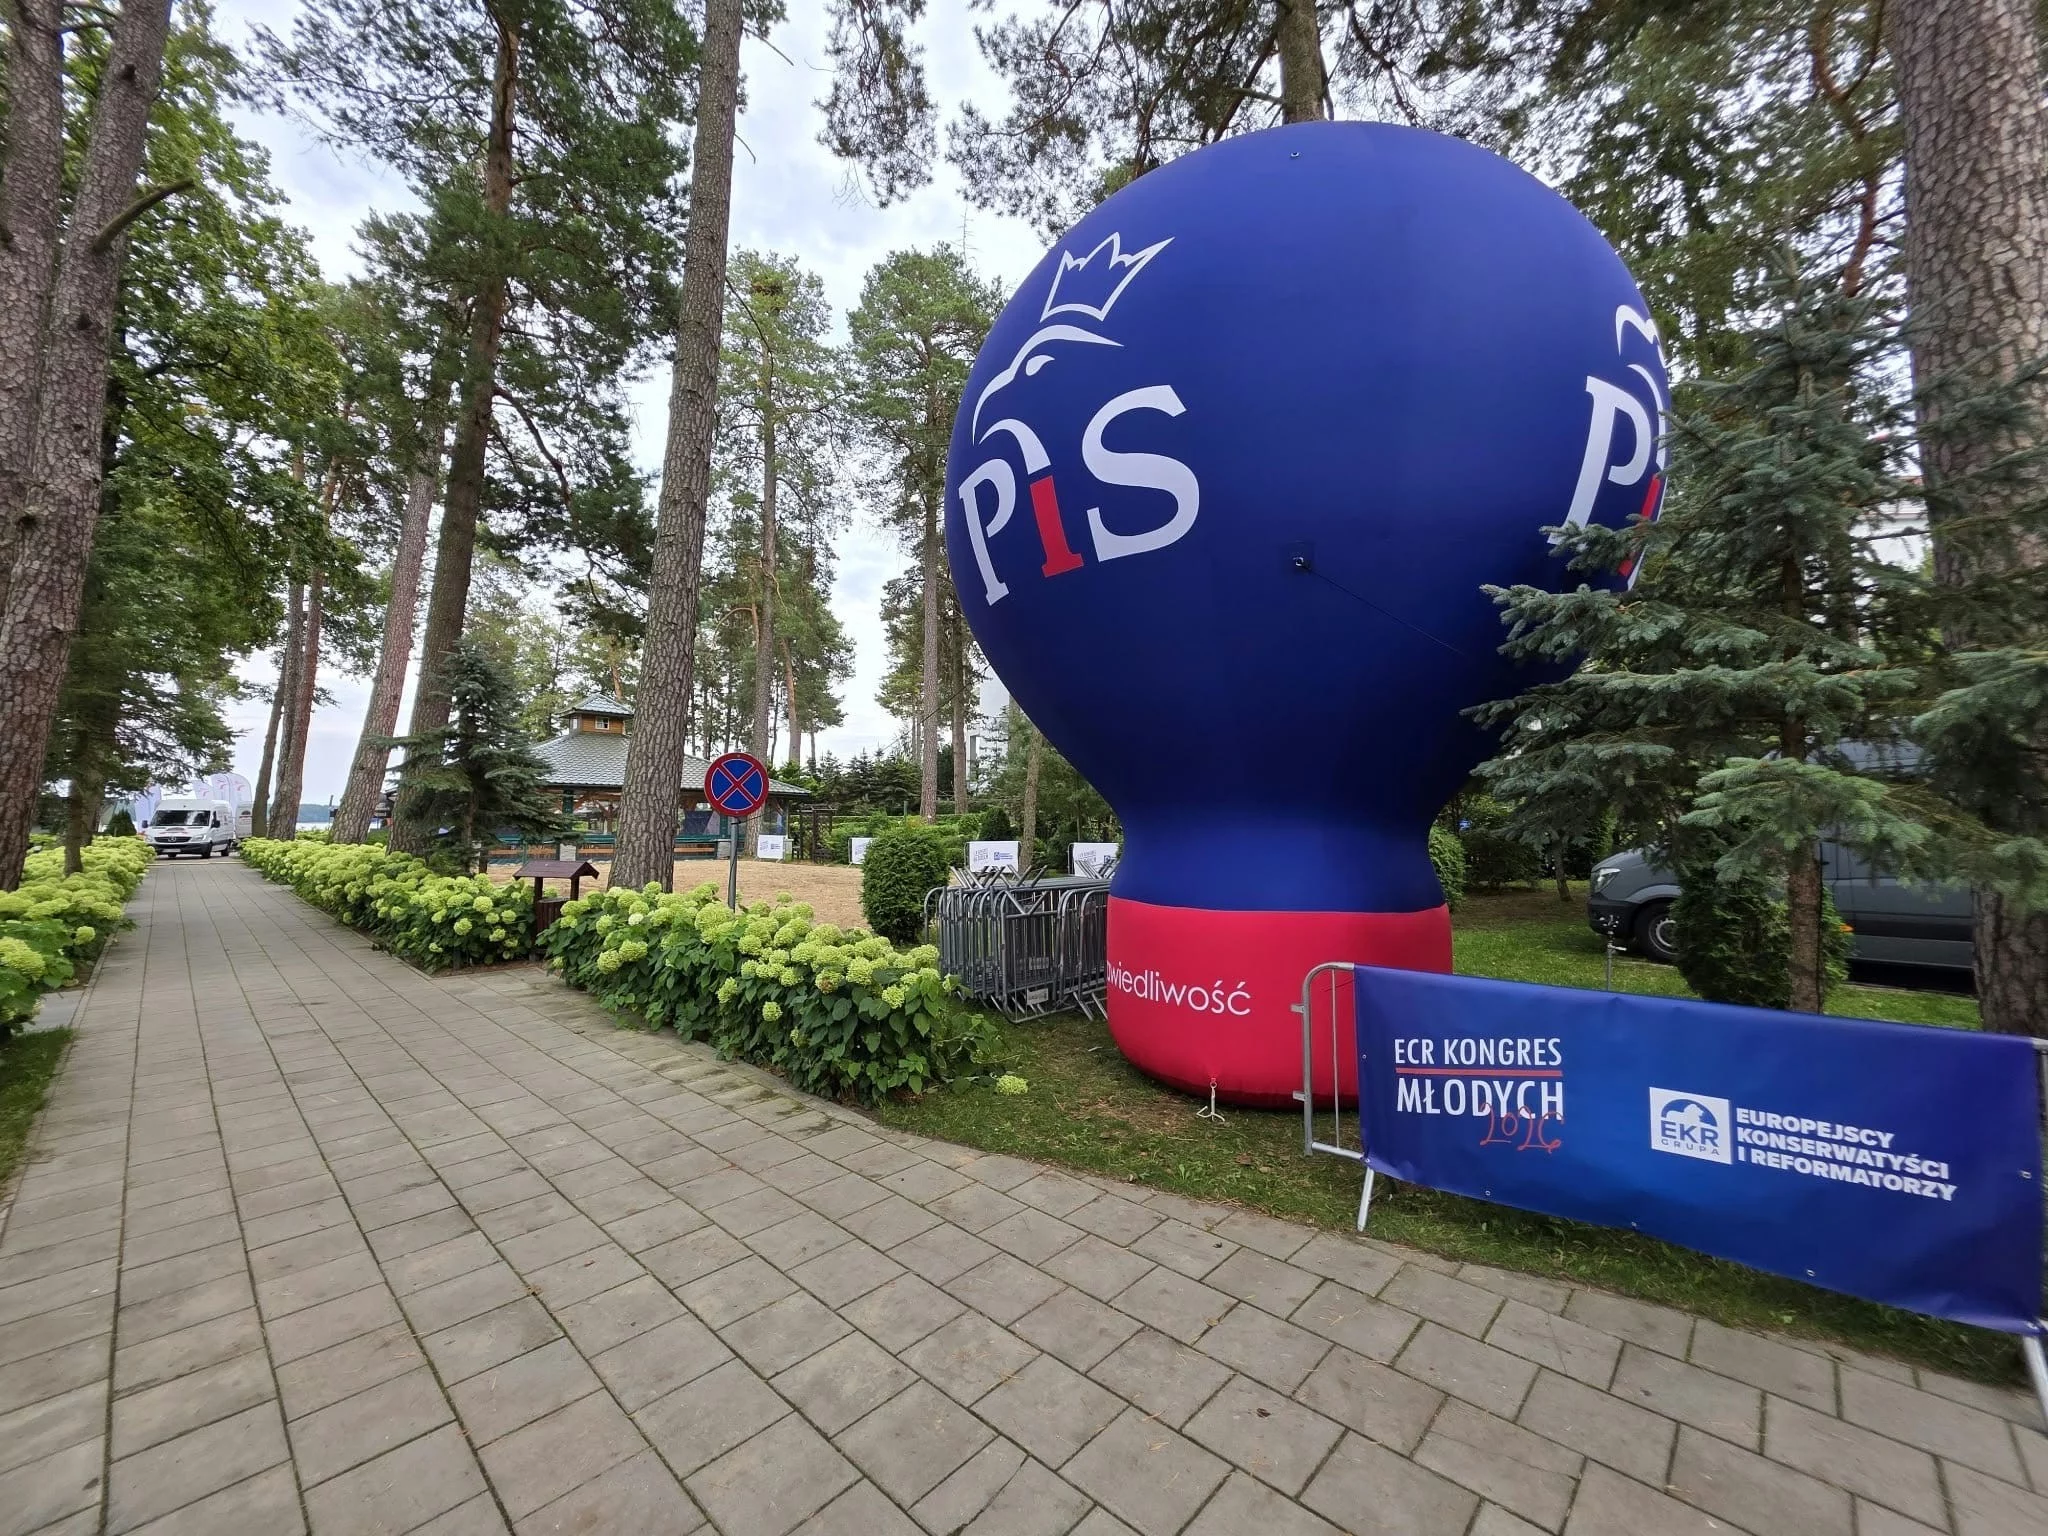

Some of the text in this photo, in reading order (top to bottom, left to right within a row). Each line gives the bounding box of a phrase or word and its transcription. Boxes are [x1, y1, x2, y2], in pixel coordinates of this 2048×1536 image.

[958, 384, 1200, 607] PiS
[1394, 1038, 1562, 1066] ECR KONGRES
[1397, 1077, 1564, 1121] MŁODYCH
[1480, 1102, 1564, 1154] 2026
[1661, 1120, 1719, 1147] EKR
[1661, 1138, 1720, 1156] GRUPA
[1736, 1107, 1895, 1149] EUROPEJSCY
[1737, 1127, 1950, 1180] KONSERWATYŚCI
[1737, 1146, 1958, 1202] I REFORMATORZY
